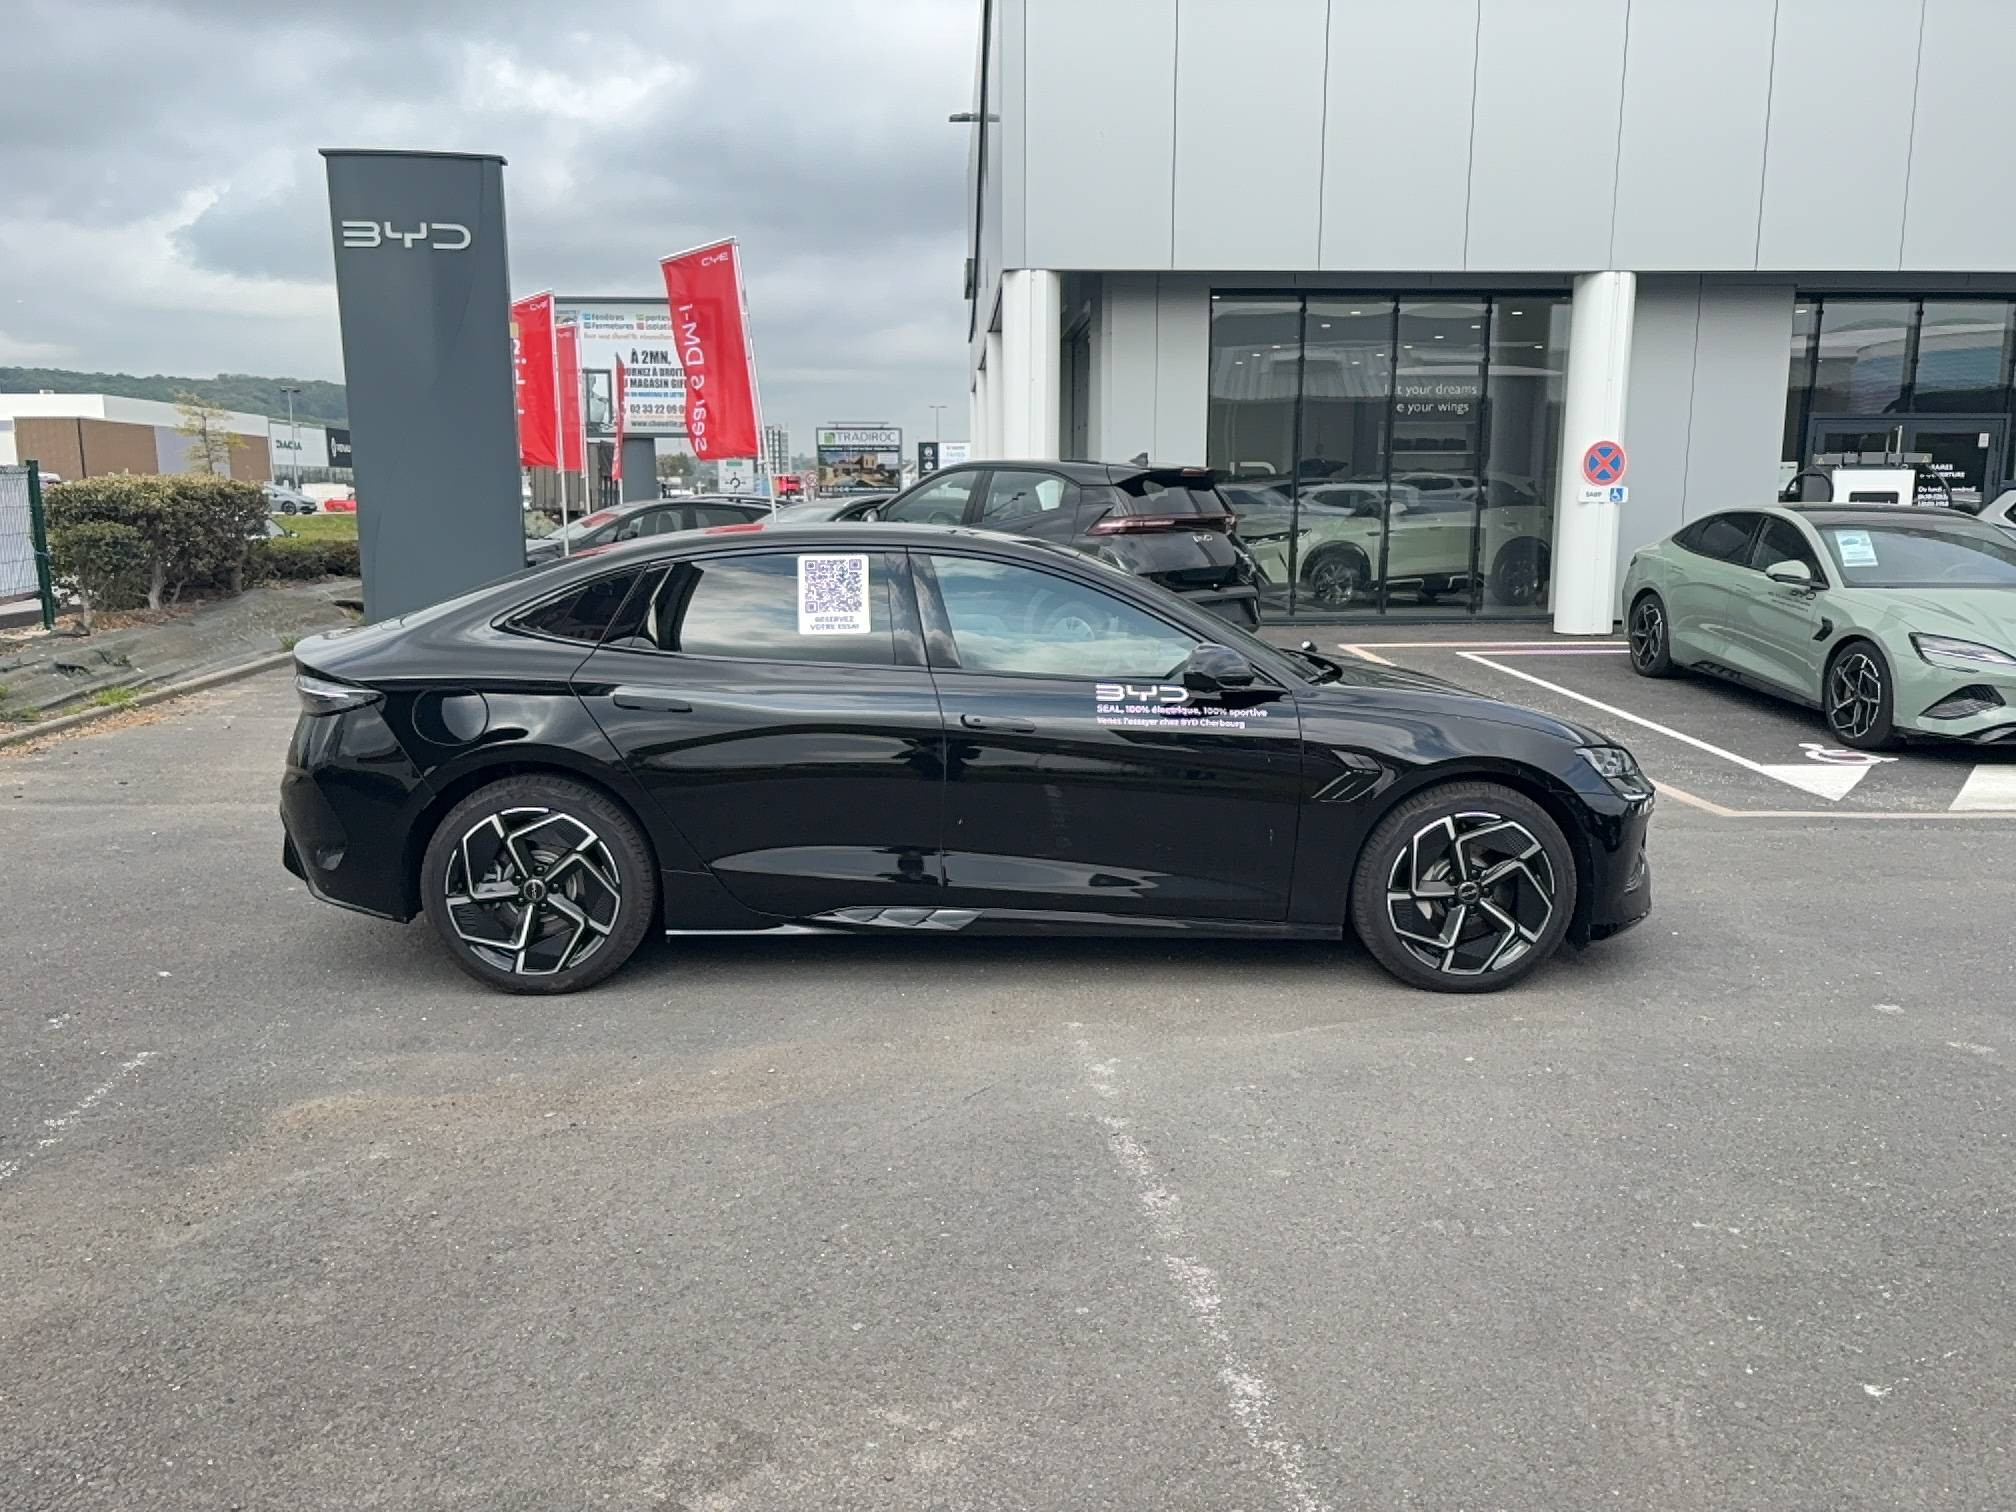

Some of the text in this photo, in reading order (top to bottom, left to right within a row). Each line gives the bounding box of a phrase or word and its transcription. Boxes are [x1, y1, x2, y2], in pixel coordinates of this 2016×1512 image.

[341, 220, 472, 250] BYD
[630, 347, 672, 367] À 2MN,
[624, 365, 684, 377] URNEZ À DROIT
[630, 378, 669, 389] MAGASIN
[671, 379, 684, 389] GIF
[1406, 385, 1433, 397] your
[1435, 383, 1478, 395] dreams
[630, 404, 640, 415] 02
[642, 404, 653, 415] 33
[655, 404, 665, 415] 22
[1407, 403, 1434, 415] your
[1437, 402, 1469, 415] wings
[276, 440, 303, 450] DACIA
[1095, 684, 1190, 703] BYD
[1125, 705, 1151, 714] 100%
[1203, 706, 1228, 716] 100%
[1229, 708, 1268, 718] sportive
[1180, 718, 1199, 726] BYD
[1199, 718, 1246, 729] Cherbourg
